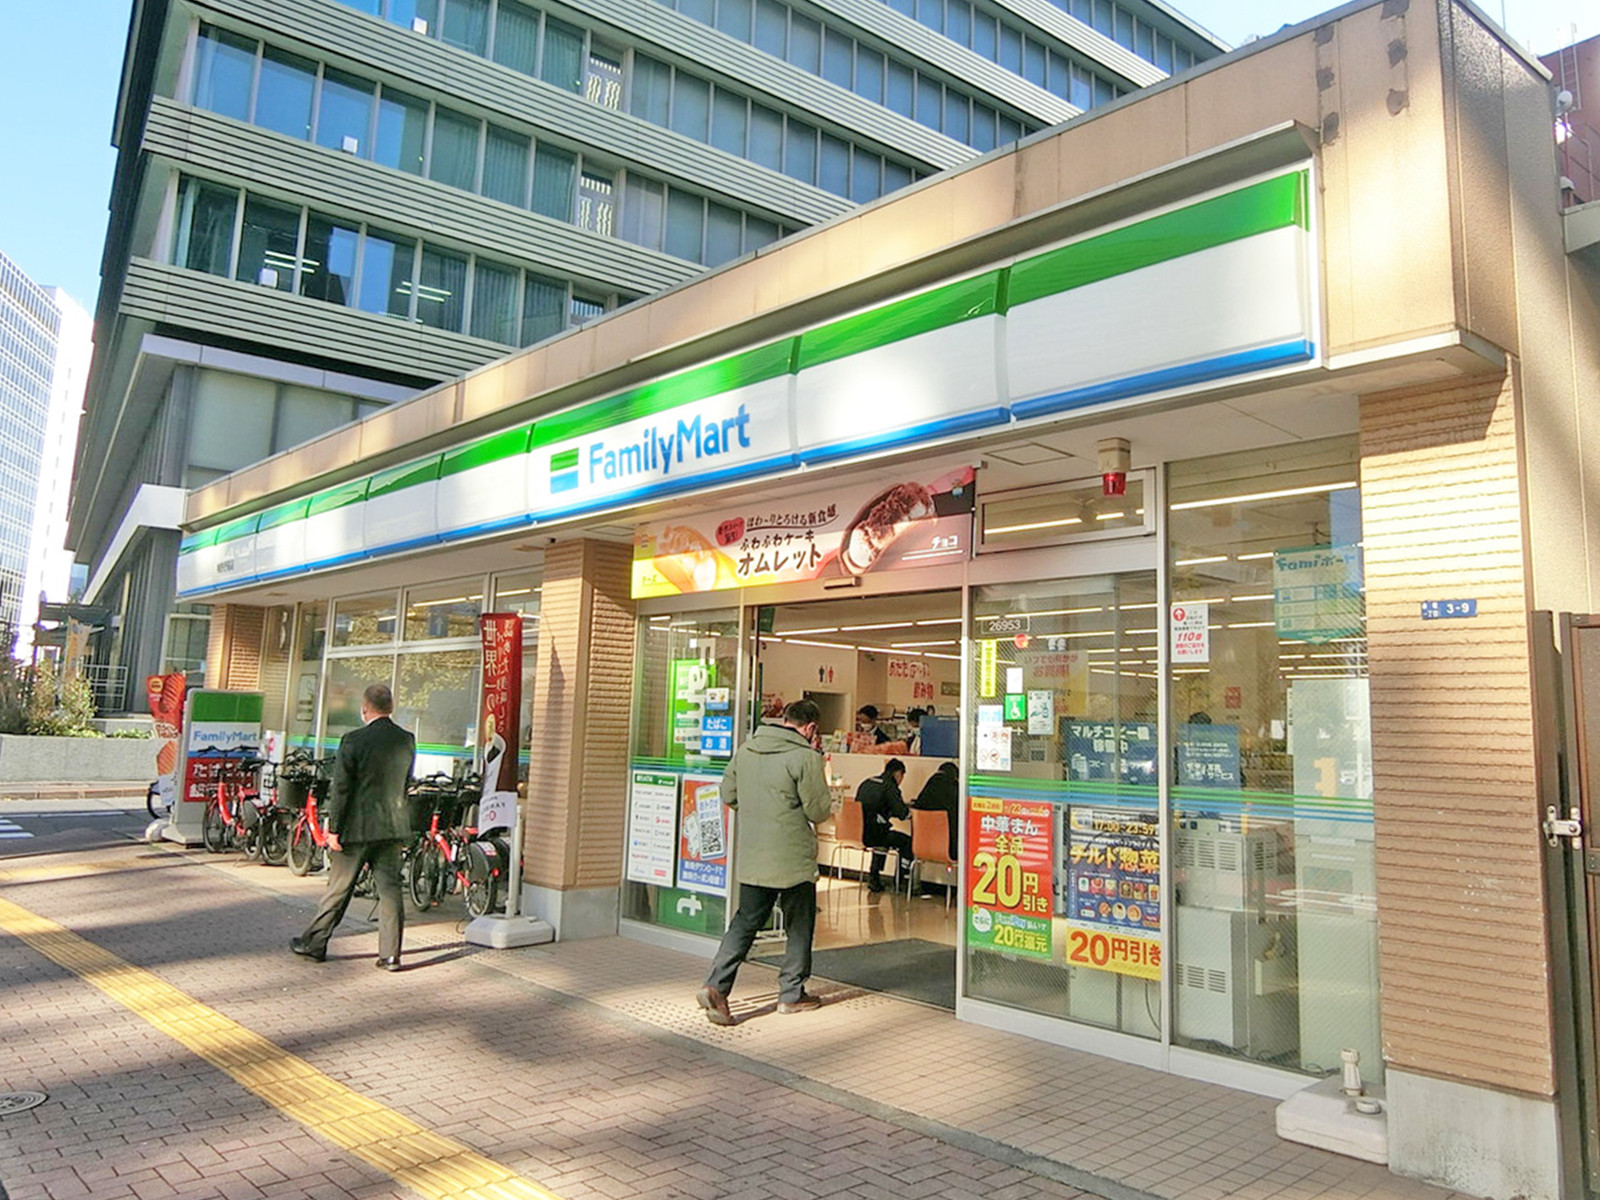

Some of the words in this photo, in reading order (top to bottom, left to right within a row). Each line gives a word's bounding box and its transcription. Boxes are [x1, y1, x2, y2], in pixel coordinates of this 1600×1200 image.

[589, 404, 750, 484] FamilyMart
[931, 535, 959, 550] チョコ
[737, 543, 822, 576] オムレット
[1446, 602, 1470, 614] 3-9
[989, 619, 1021, 631] 26953
[193, 730, 258, 744] FamilyMart
[980, 814, 1038, 836] 中華まん
[994, 834, 1024, 854] 全品
[972, 851, 1022, 908] 20
[1023, 873, 1038, 893] 円
[1023, 894, 1048, 913] 引き
[1070, 930, 1161, 967] 20円引き
